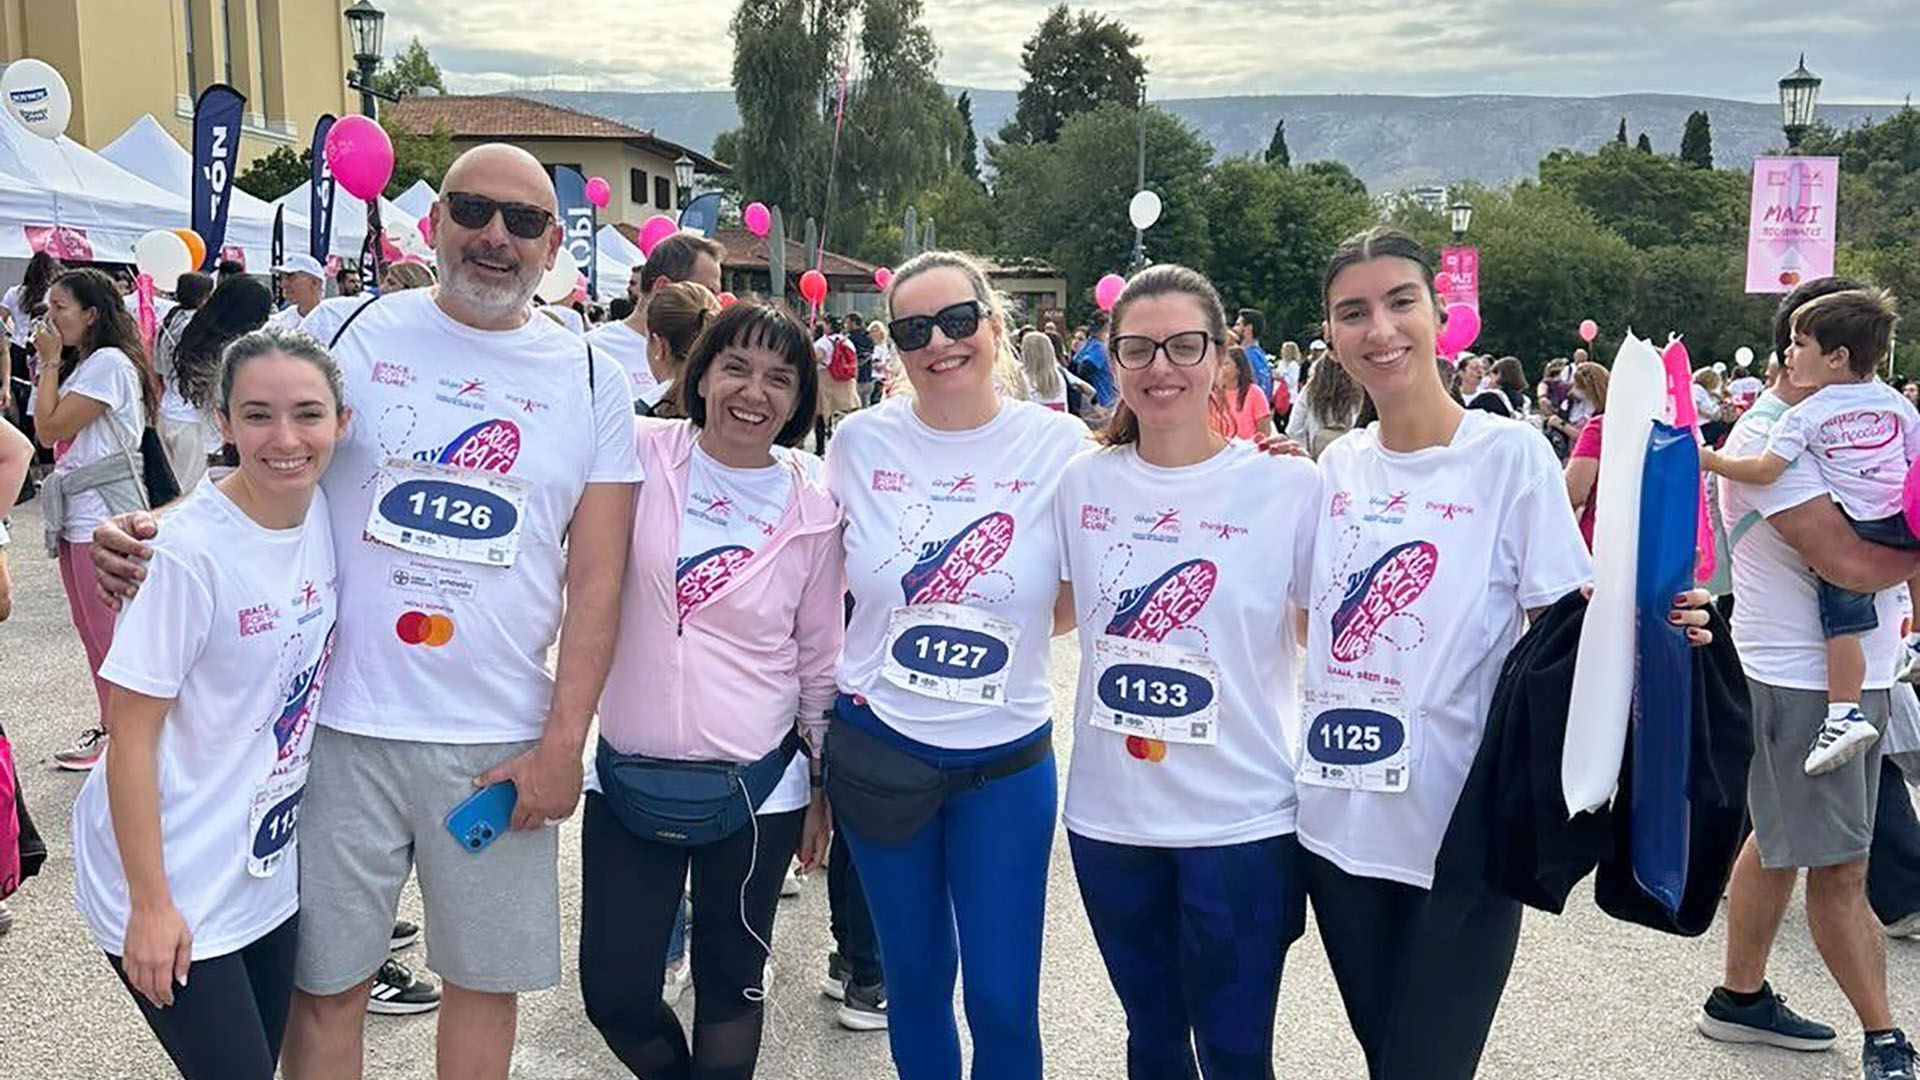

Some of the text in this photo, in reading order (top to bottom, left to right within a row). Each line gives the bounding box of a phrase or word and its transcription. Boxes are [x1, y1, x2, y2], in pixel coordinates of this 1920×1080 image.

[409, 491, 492, 530] 1126
[954, 529, 1003, 567] RACE
[941, 552, 976, 587] FOR
[1373, 557, 1419, 607] RACE
[1153, 575, 1200, 621] RACE
[1363, 584, 1392, 624] FOR
[1140, 601, 1172, 638] FOR
[916, 636, 988, 668] 1127
[1115, 675, 1188, 707] 1133
[1320, 723, 1381, 751] 1125
